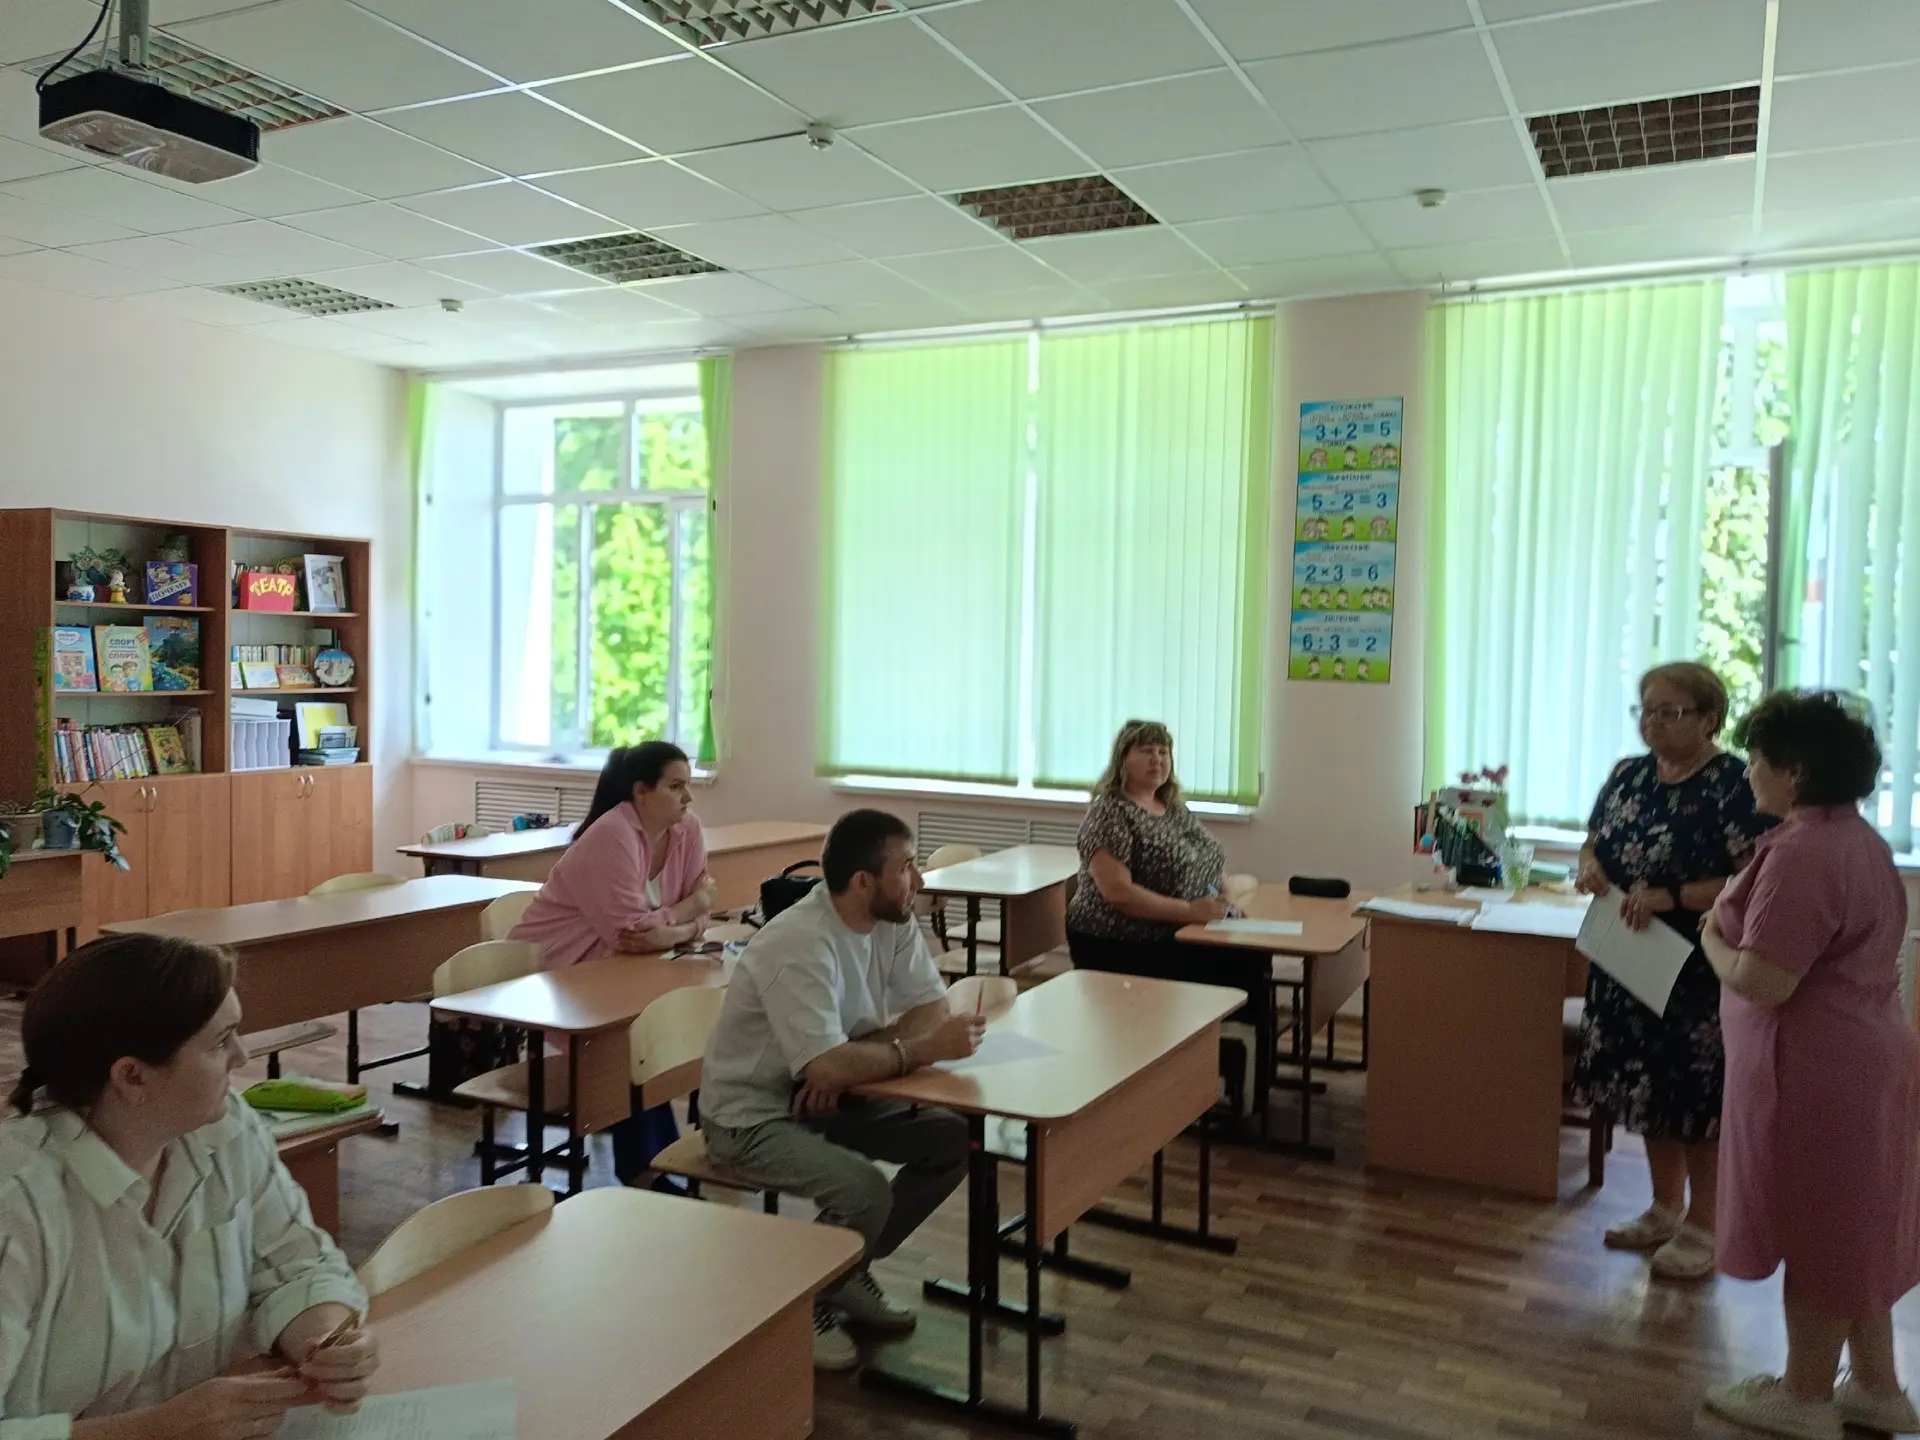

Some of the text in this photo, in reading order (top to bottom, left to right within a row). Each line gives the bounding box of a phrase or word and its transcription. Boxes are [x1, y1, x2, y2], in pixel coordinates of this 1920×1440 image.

[1316, 420, 1391, 441] 3 + 2 = 5
[1312, 494, 1323, 510] 5
[1342, 493, 1354, 510] 2
[1359, 494, 1371, 504] =
[1376, 492, 1387, 508] 3
[1305, 564, 1317, 582] 2
[1333, 564, 1344, 582] 3
[1351, 567, 1363, 577] =
[1368, 564, 1378, 582] 6
[250, 577, 294, 597] ТЕАТР
[1302, 634, 1377, 653] 6 : 3 = 2
